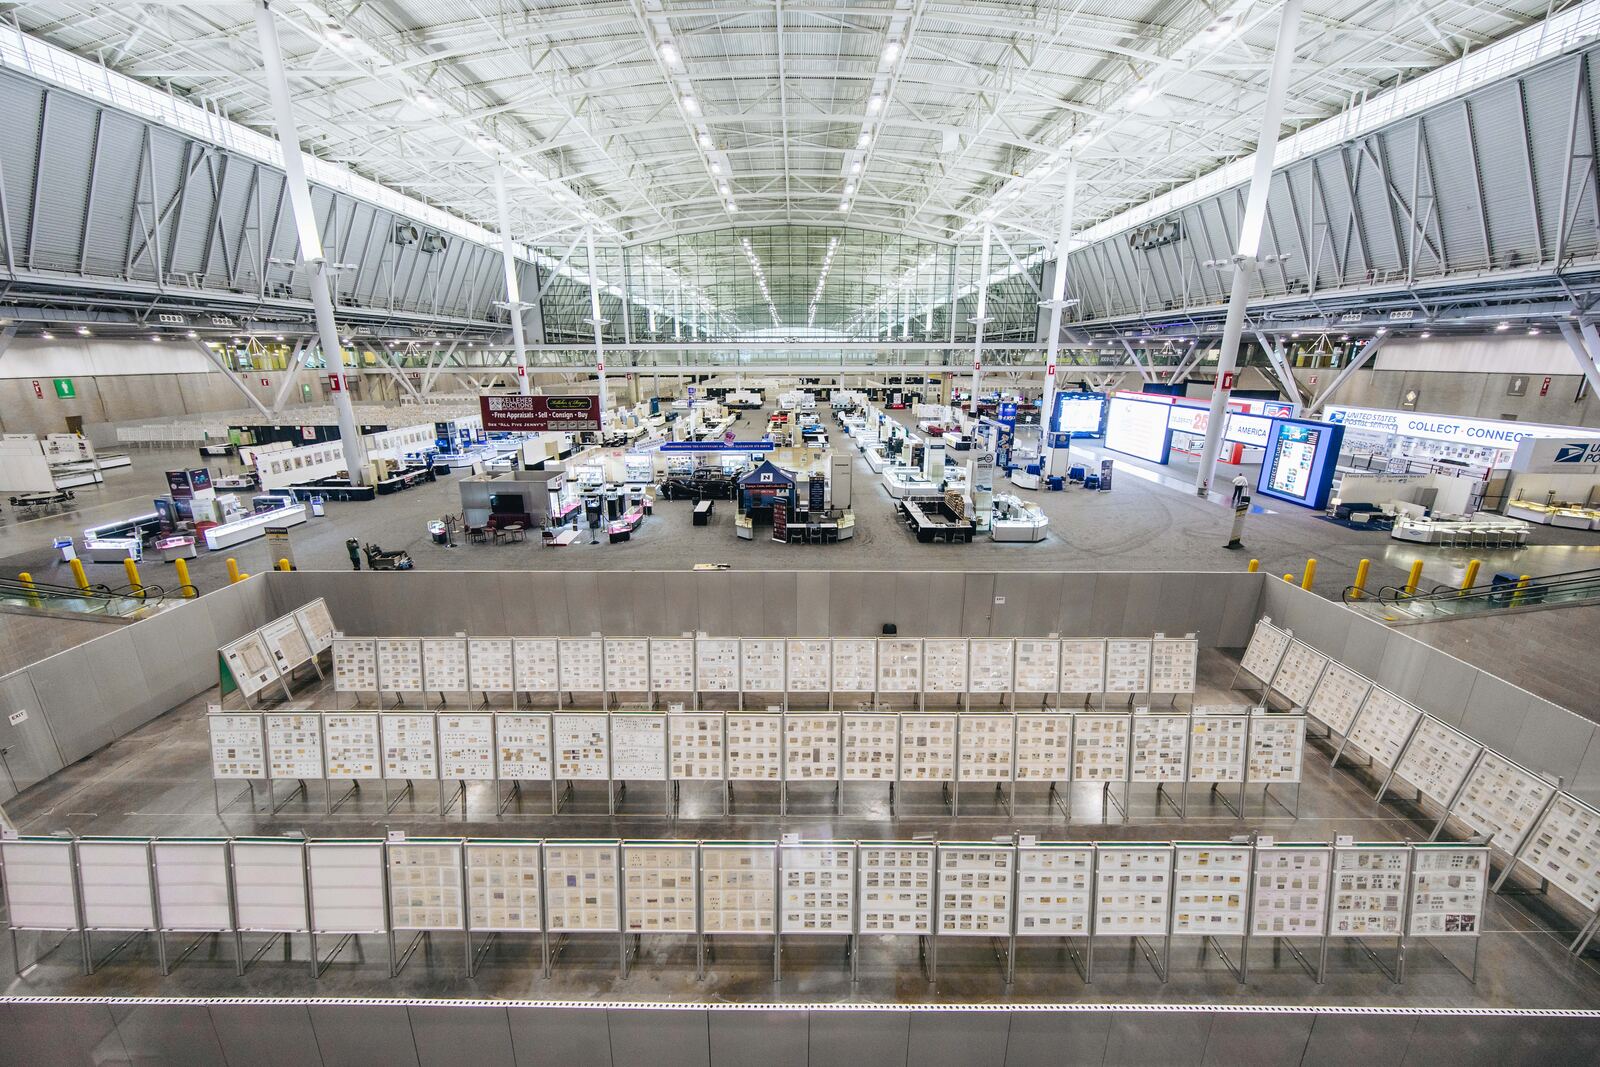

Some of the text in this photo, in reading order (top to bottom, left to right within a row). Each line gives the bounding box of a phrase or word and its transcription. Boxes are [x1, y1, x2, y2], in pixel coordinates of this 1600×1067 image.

[1347, 412, 1397, 422] UNITED STATES
[1238, 426, 1267, 436] AMERICA
[1408, 420, 1533, 442] COLLECT CONNEC
